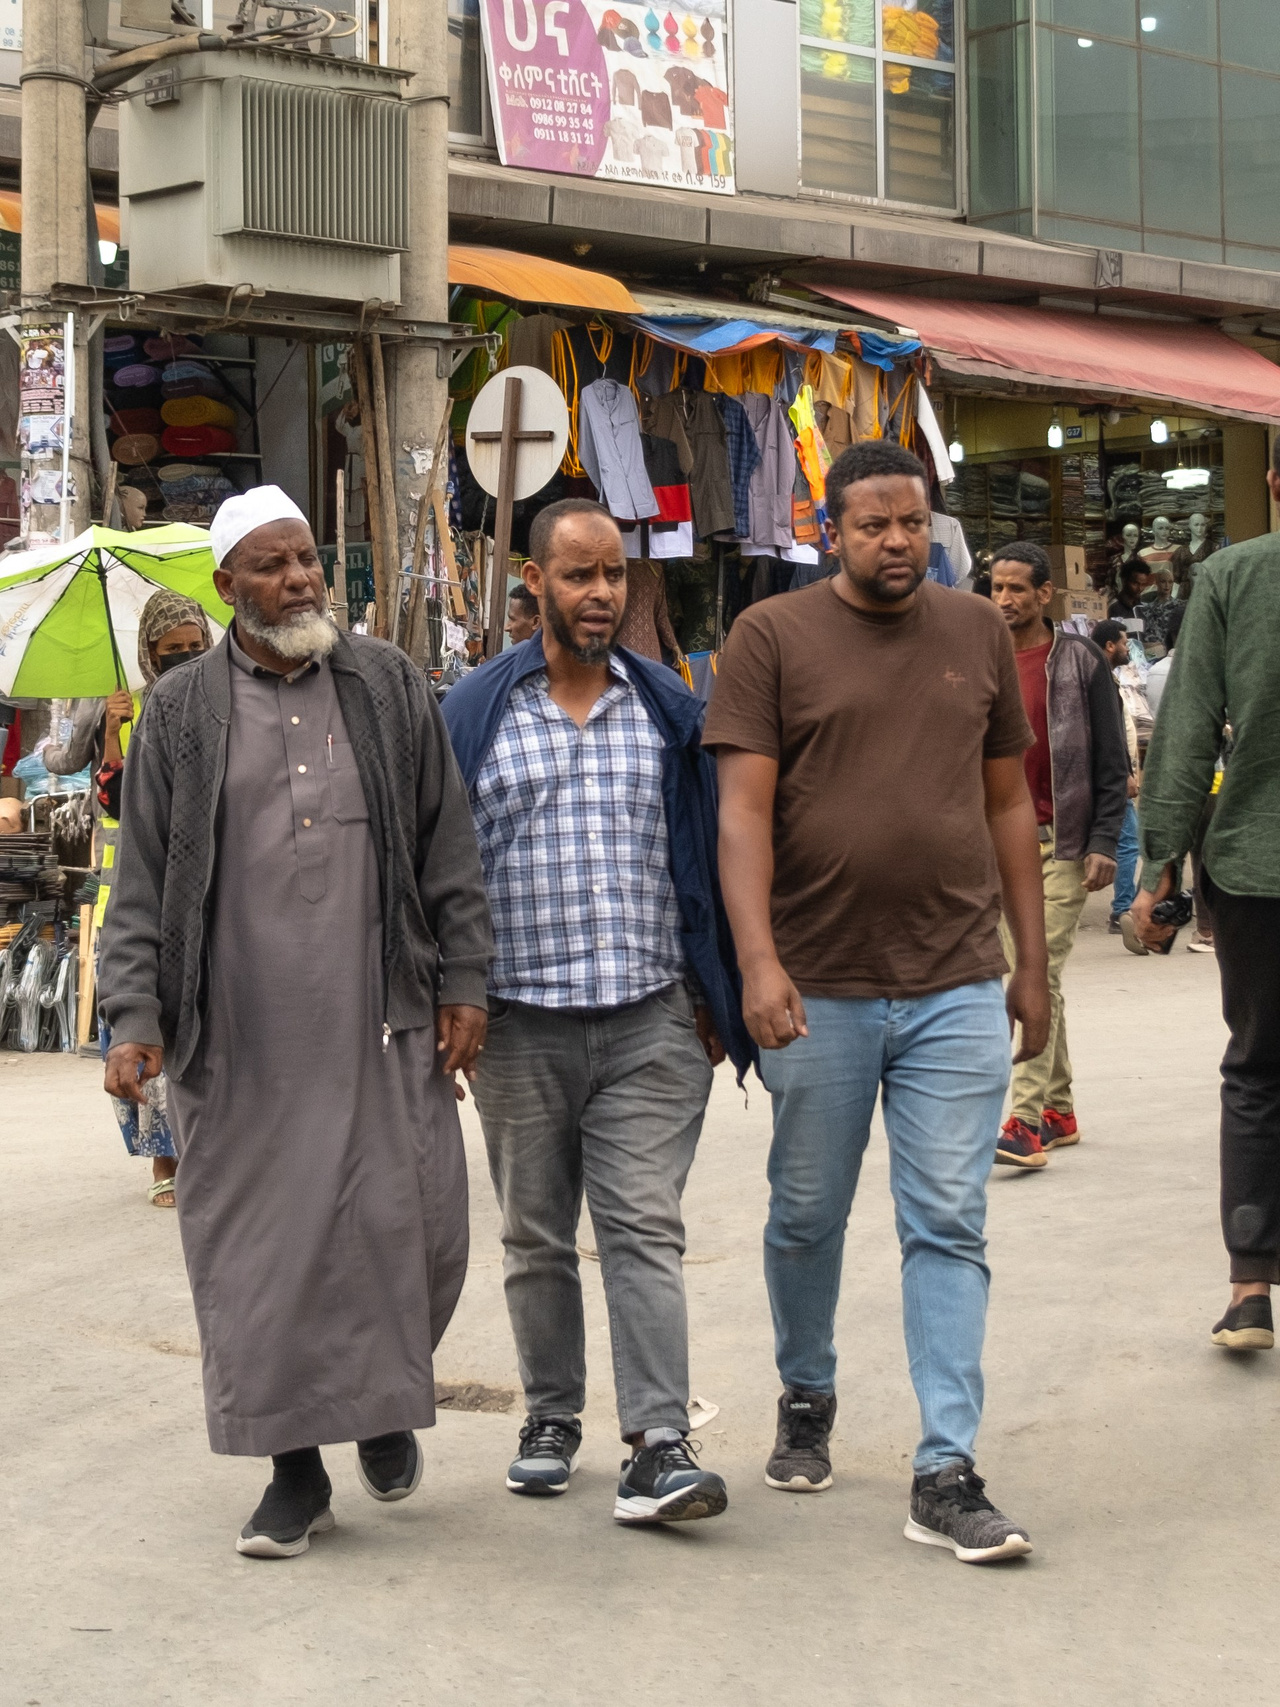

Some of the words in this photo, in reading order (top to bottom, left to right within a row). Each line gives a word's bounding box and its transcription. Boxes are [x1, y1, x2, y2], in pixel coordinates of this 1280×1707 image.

[529, 96, 553, 111] 0912
[554, 98, 565, 112] 08
[566, 101, 578, 114] 27
[580, 103, 593, 116] 84
[531, 112, 554, 127] 0986
[555, 115, 567, 128] 99
[568, 116, 580, 129] 35
[582, 118, 594, 131] 45
[533, 128, 556, 142] 0911
[558, 130, 569, 143] 18
[570, 132, 582, 144] 31
[584, 133, 595, 146] 21
[710, 173, 727, 188] 159
